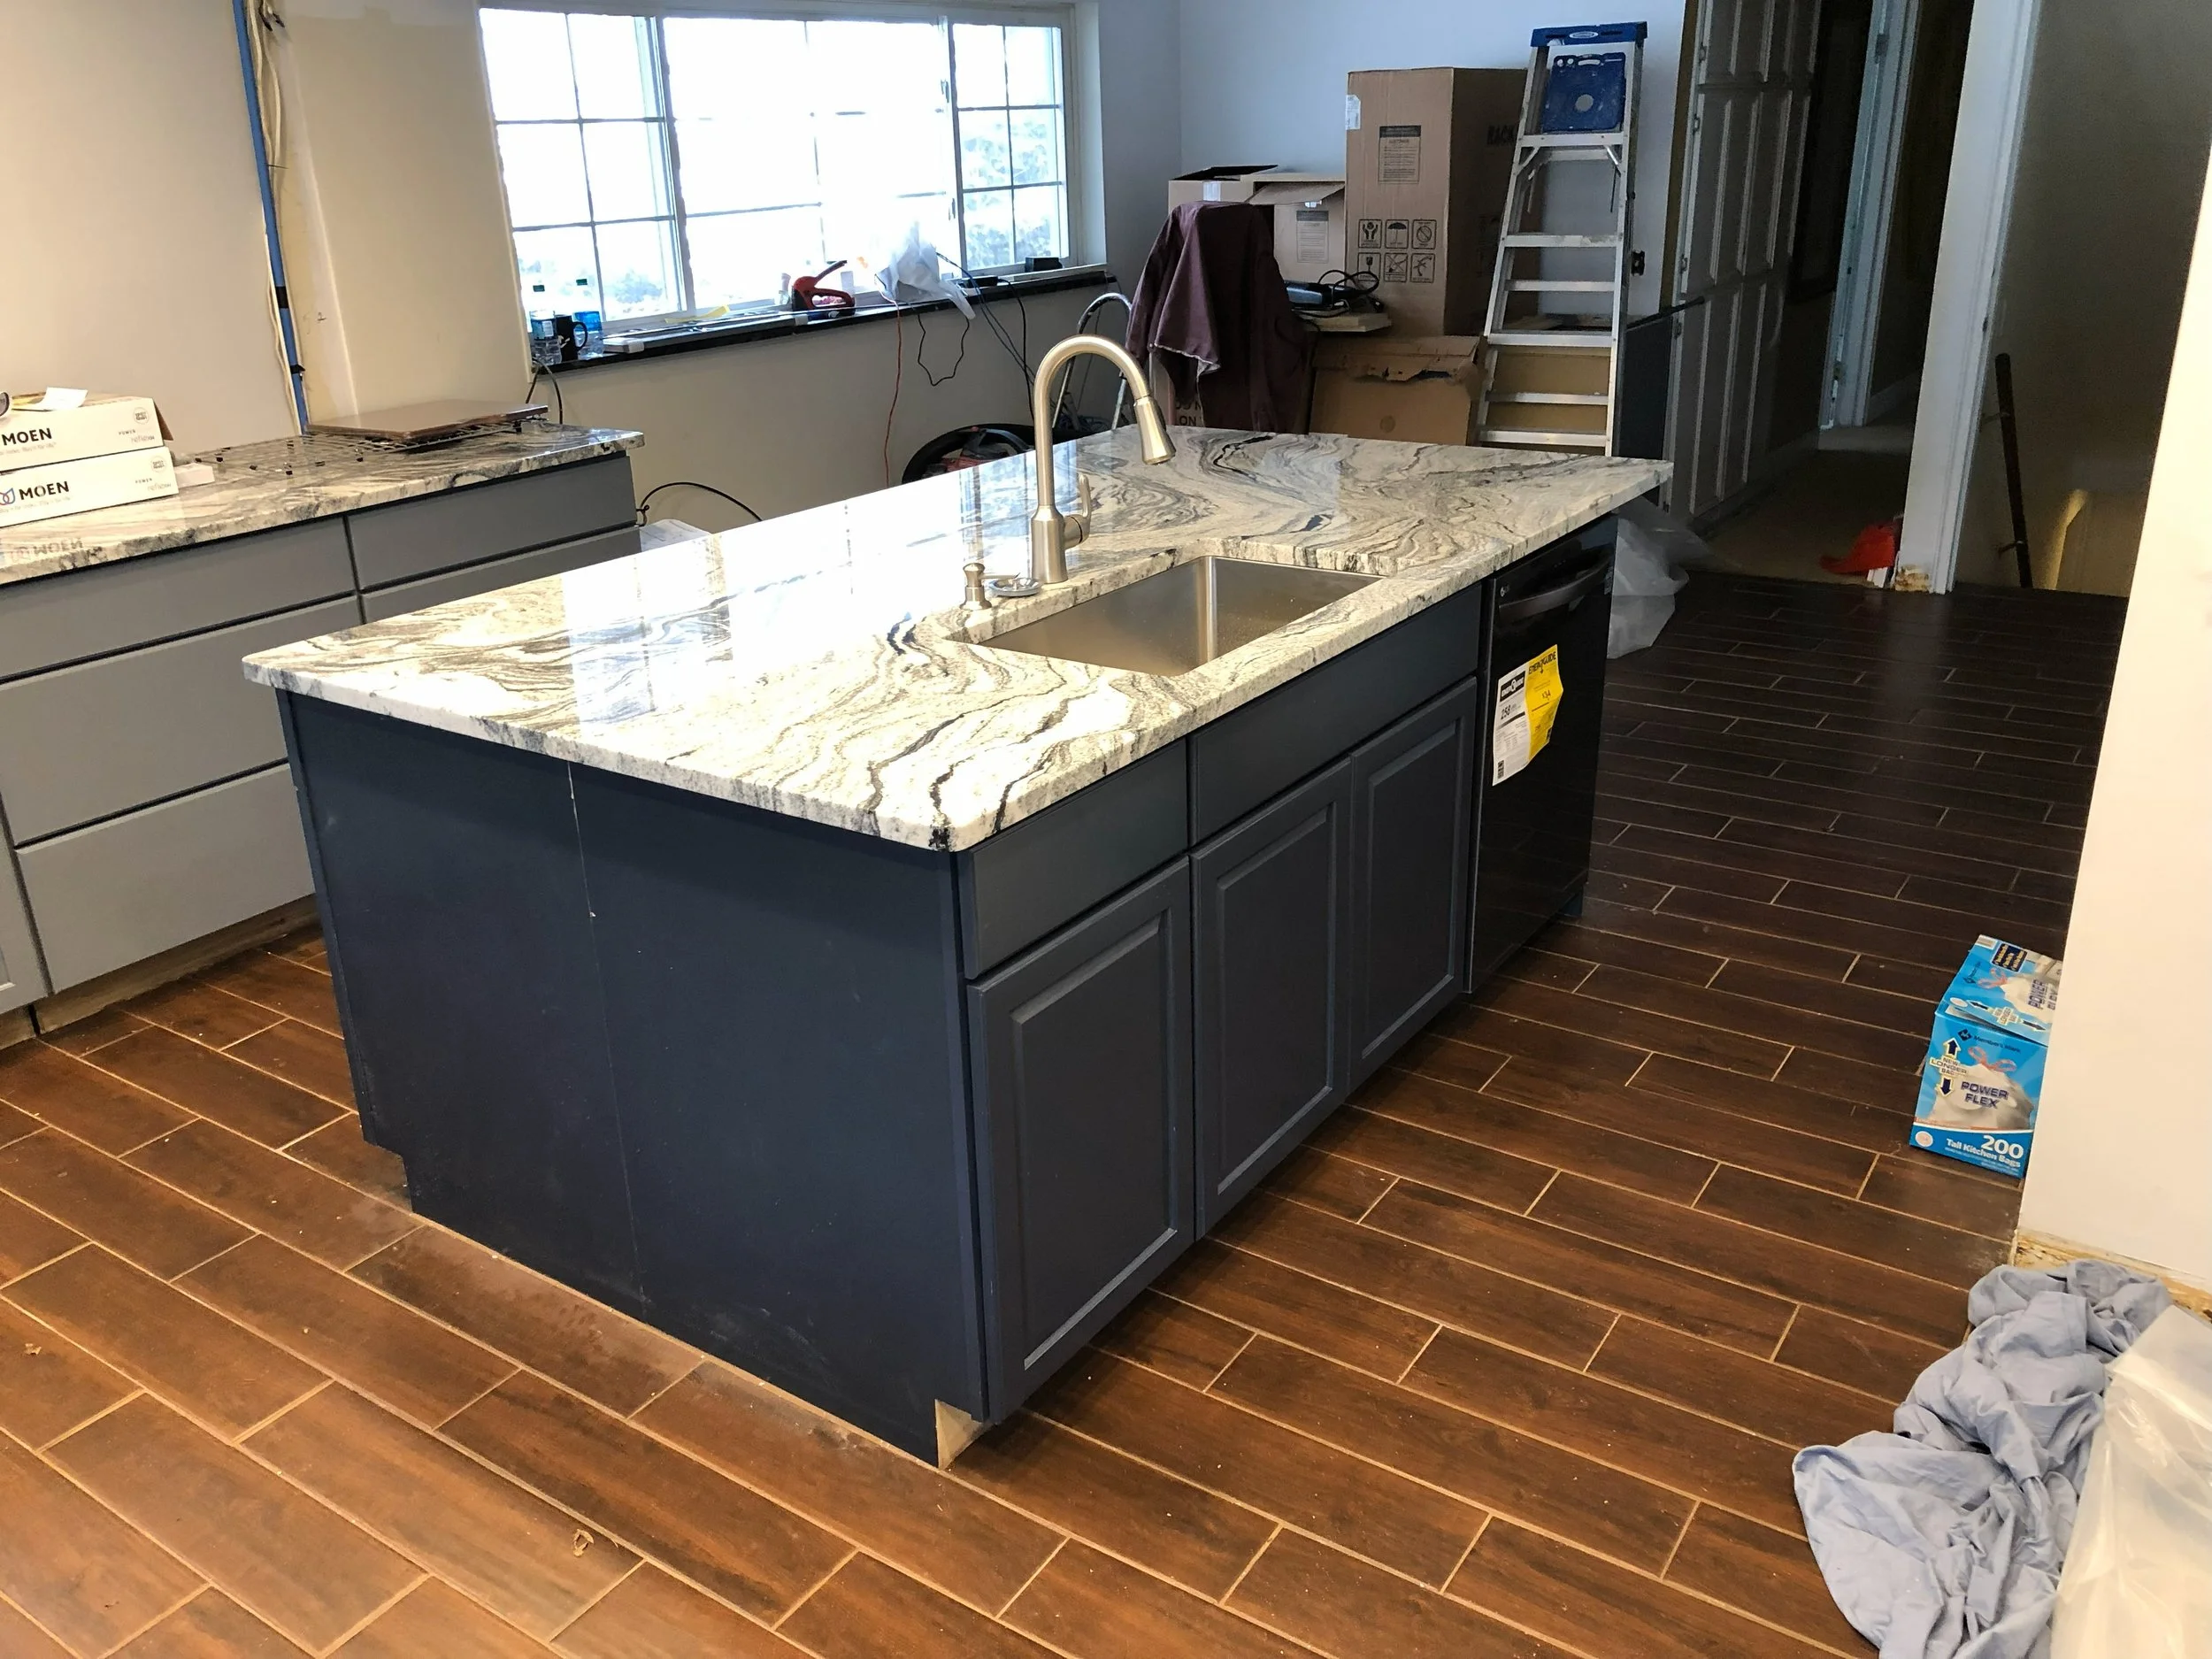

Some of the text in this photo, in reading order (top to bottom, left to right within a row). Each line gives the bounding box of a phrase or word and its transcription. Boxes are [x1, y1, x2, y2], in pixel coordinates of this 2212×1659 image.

[2, 428, 52, 446] MOEN
[19, 480, 69, 500] MOEN
[1932, 1059, 1967, 1074] LONGER
[1943, 1057, 1958, 1066] NEW
[1961, 1081, 2009, 1100] POWER
[1965, 1094, 1999, 1109] FLEX
[1947, 1138, 1962, 1149] Tall
[1963, 1143, 1997, 1160] Kitchen
[1999, 1155, 2021, 1168] Bags
[1981, 1134, 2024, 1159] 200
